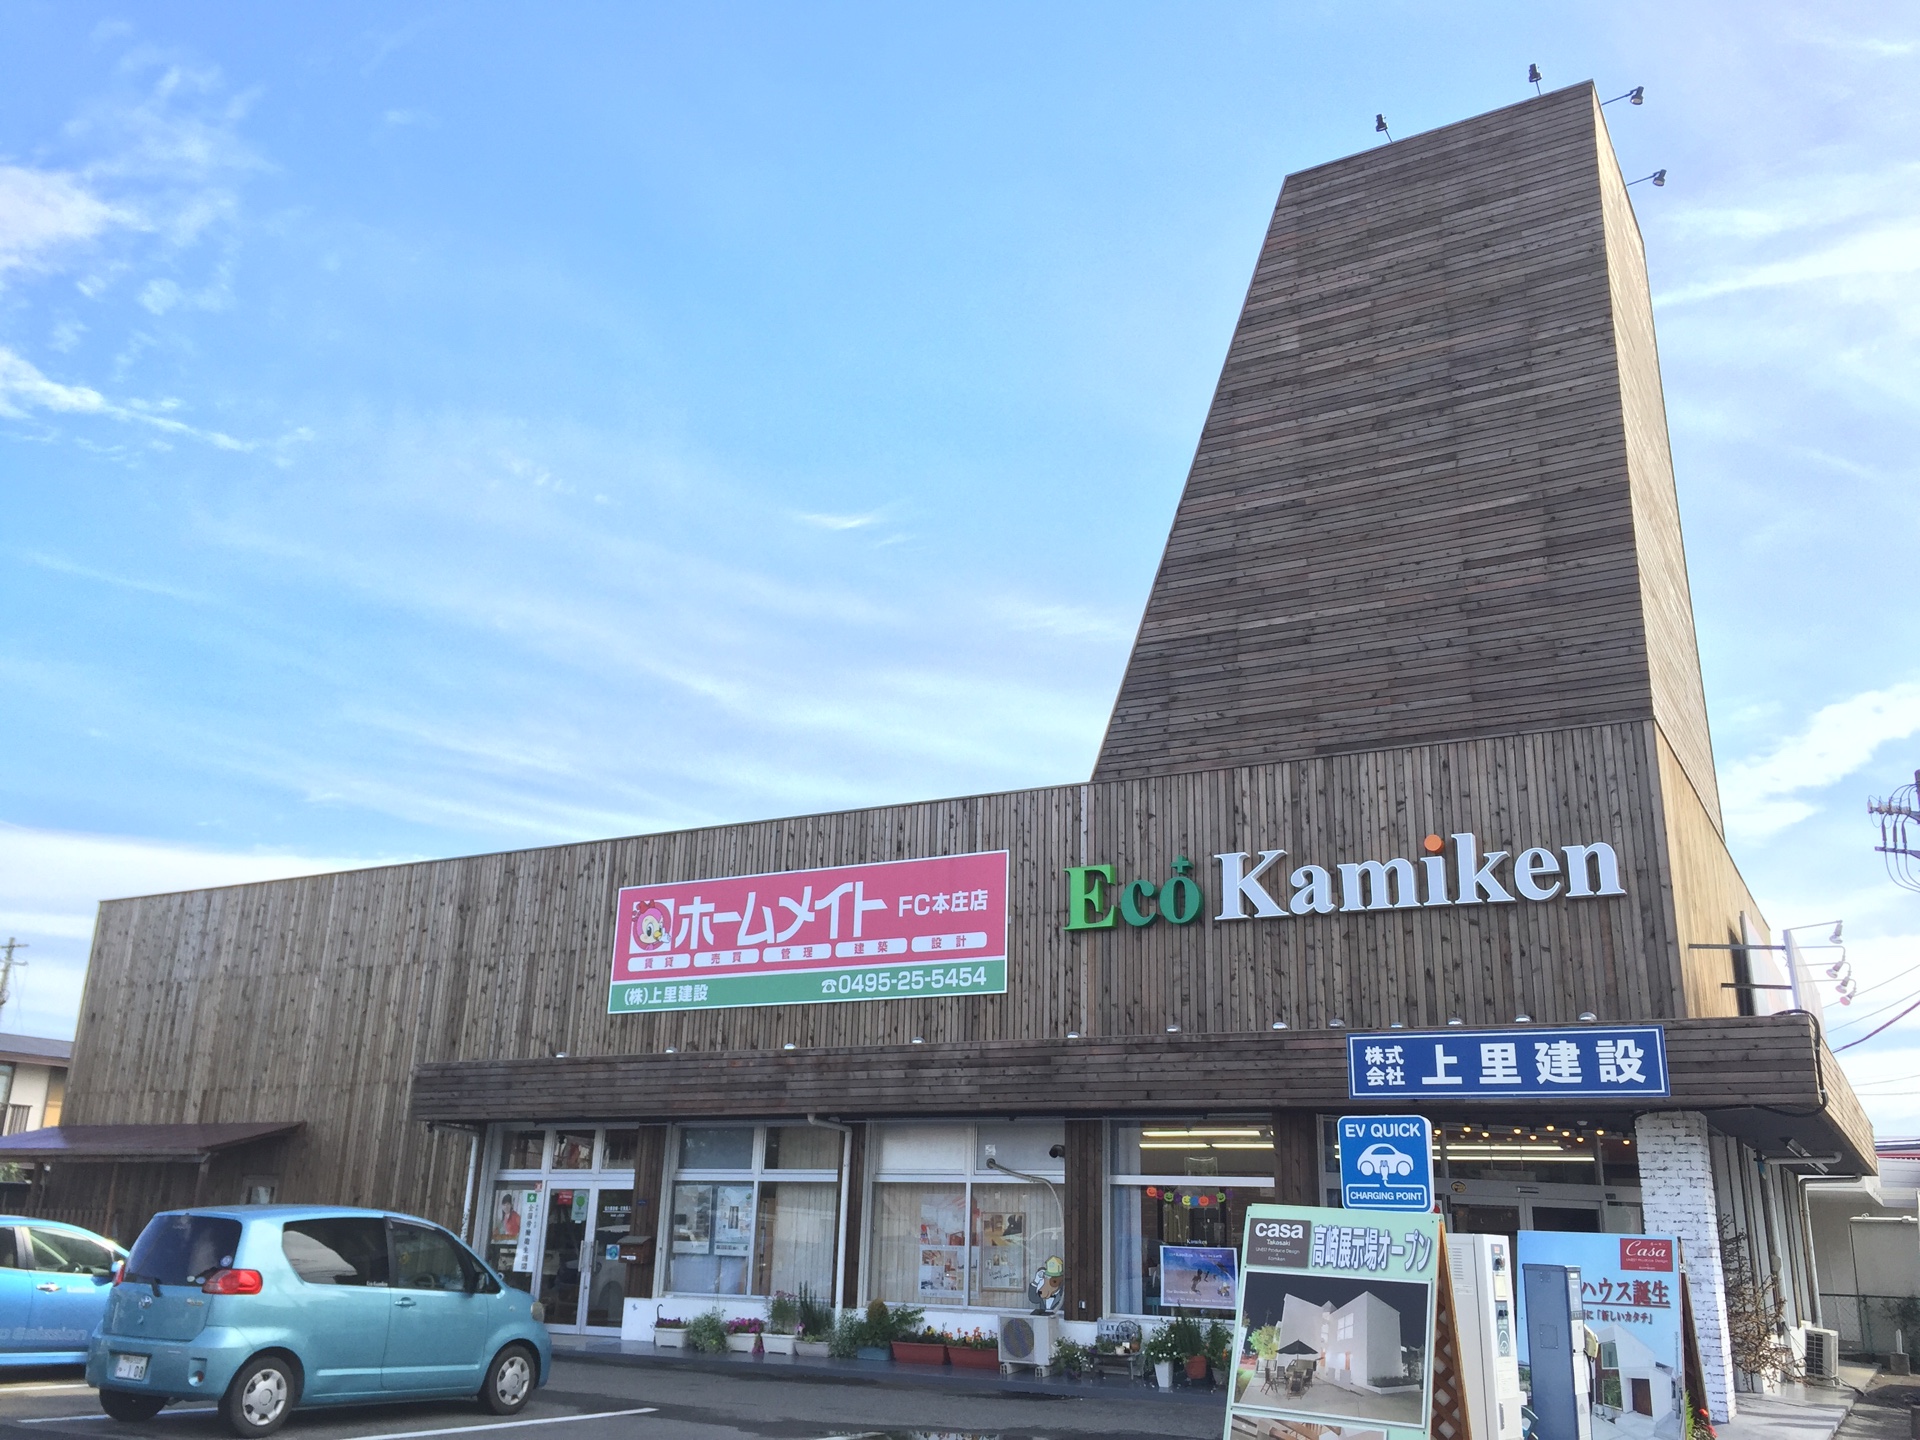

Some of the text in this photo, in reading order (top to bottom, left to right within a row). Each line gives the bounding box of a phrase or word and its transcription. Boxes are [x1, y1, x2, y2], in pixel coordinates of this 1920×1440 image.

[1064, 832, 1627, 931] Eco Kamiken
[675, 881, 888, 949] ホームメイト
[898, 889, 988, 917] FC本庄店
[710, 951, 742, 965] 売買
[781, 946, 813, 960] 管理
[854, 941, 888, 954] 建築
[931, 935, 966, 949] 設計
[838, 966, 987, 994] 0495-25-5454
[624, 984, 709, 1005] (株)上里建設
[1365, 1046, 1405, 1065] 株式
[1421, 1039, 1647, 1085] 上里建設
[1365, 1066, 1406, 1086] 会社
[1345, 1123, 1421, 1138] EV QUICK
[1350, 1191, 1422, 1200] CHARGING POINT
[1255, 1222, 1304, 1239] casa
[1312, 1224, 1432, 1272] 高崎展示場オープン
[1625, 1240, 1667, 1257] Casa
